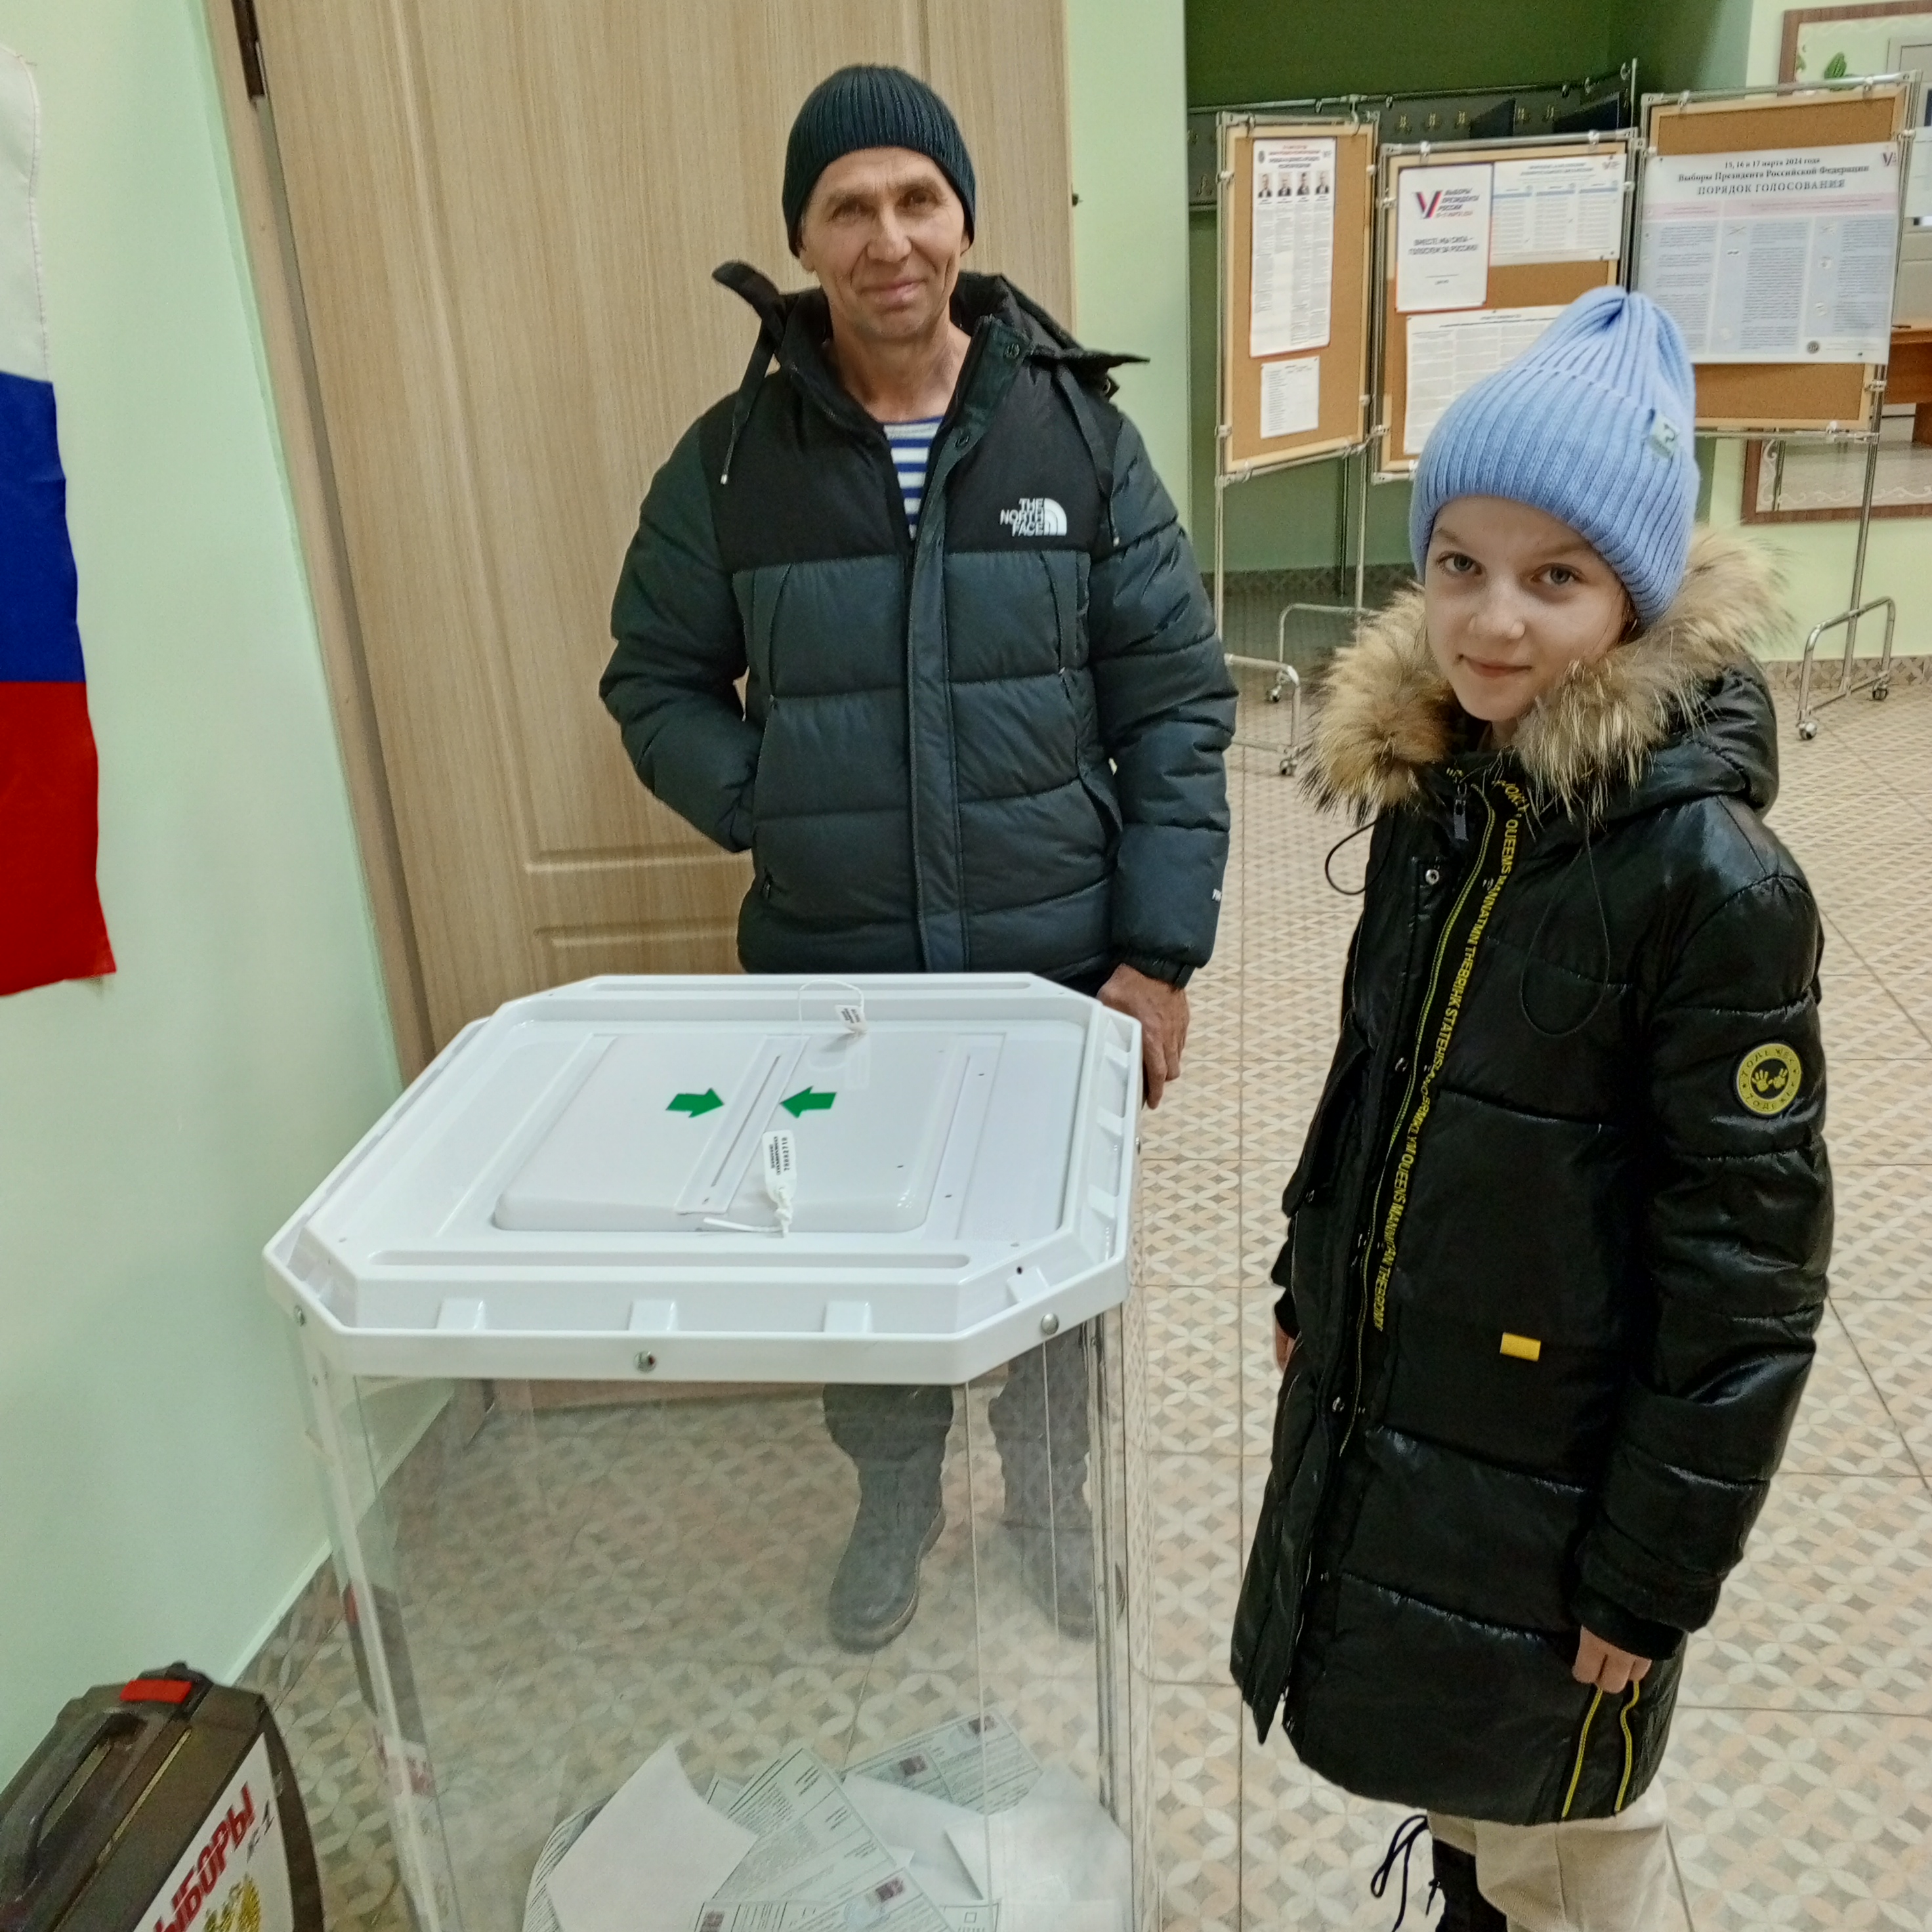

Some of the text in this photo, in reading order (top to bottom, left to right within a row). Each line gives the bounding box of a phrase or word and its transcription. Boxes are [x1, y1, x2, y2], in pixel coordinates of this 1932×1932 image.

[1678, 165, 1870, 182] Выборы Президента Российской Федерации
[1698, 179, 1845, 196] ПОРЯДОК ГОЛОСОВАНИЯ
[1018, 498, 1043, 512] THE
[999, 509, 1043, 525] NORTH
[1012, 522, 1043, 536] FACE
[153, 1780, 255, 1932] ЫБОРЫ
